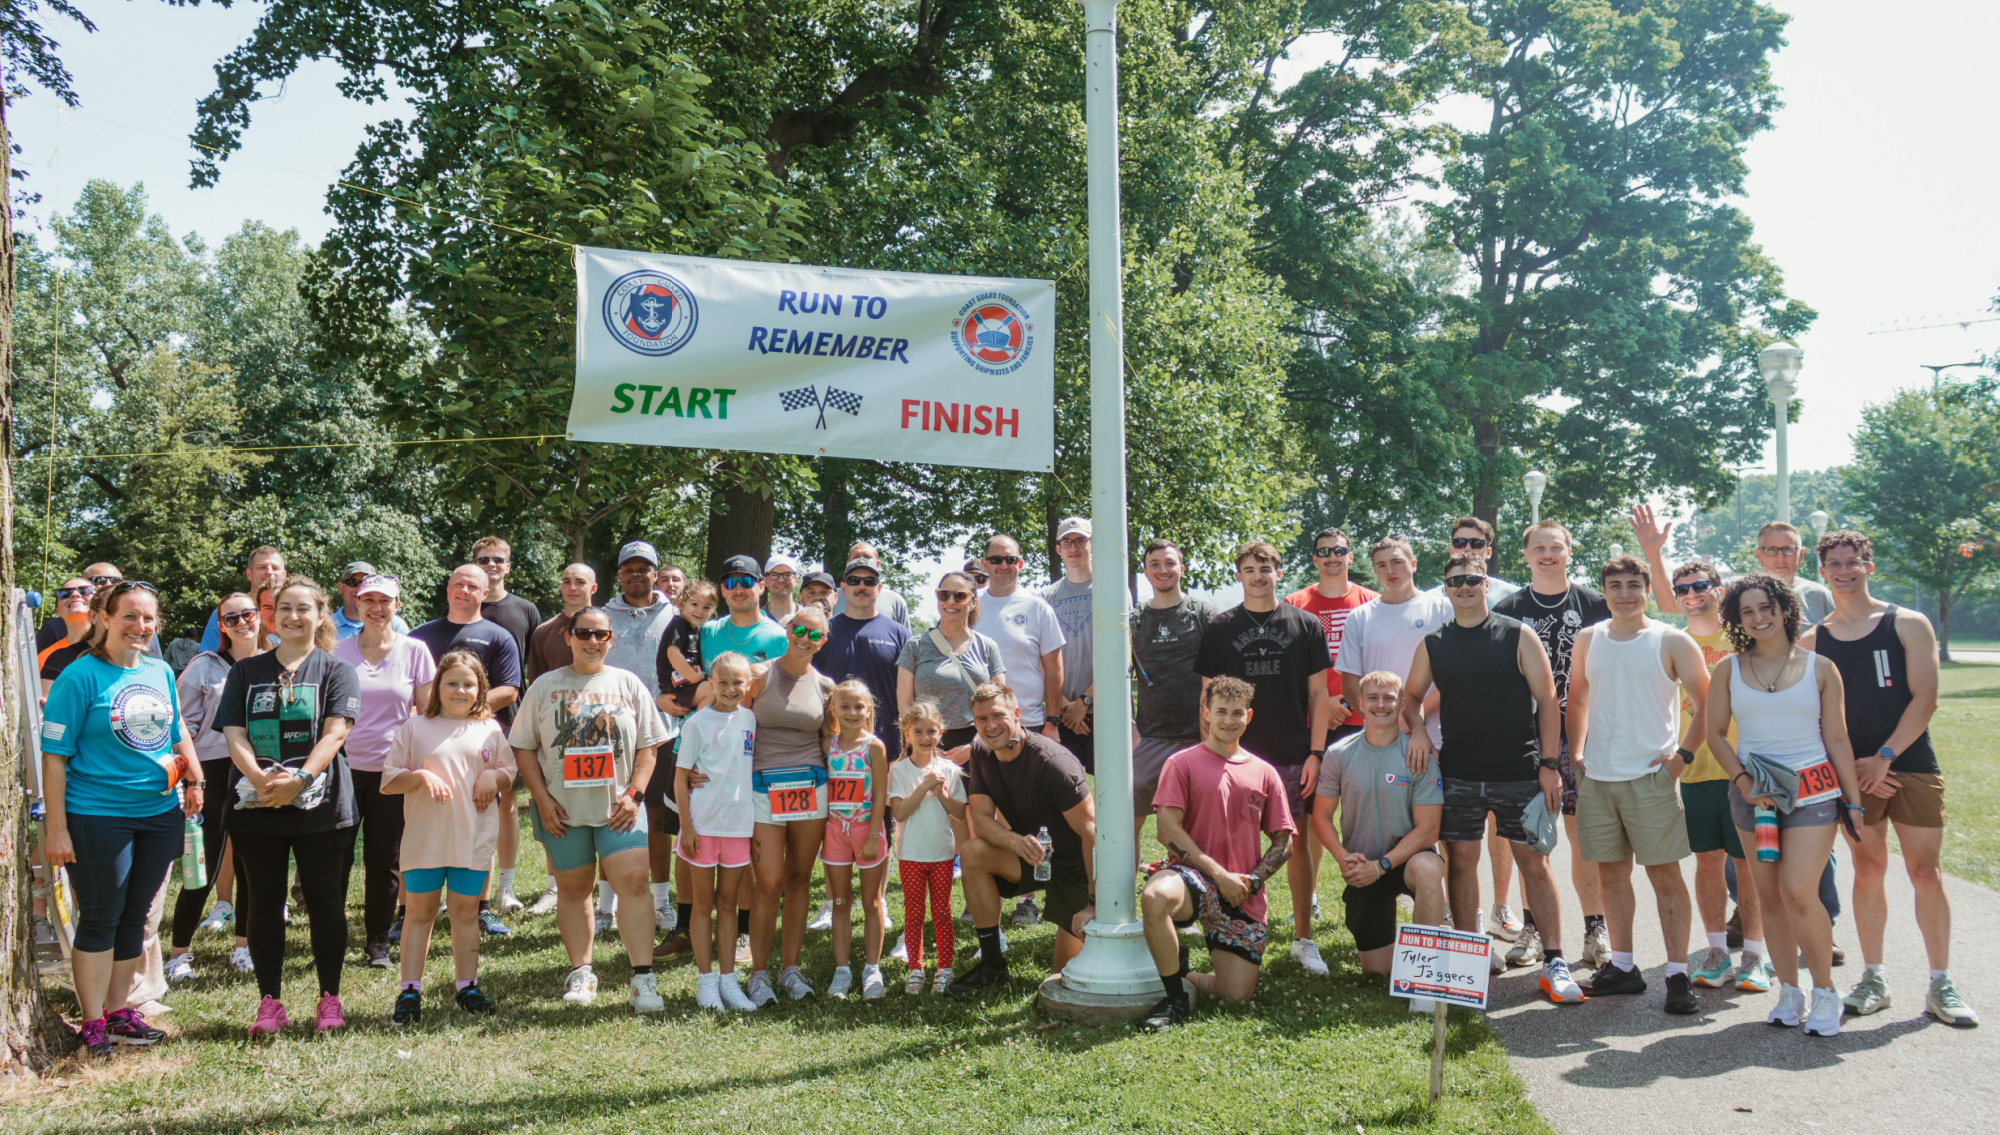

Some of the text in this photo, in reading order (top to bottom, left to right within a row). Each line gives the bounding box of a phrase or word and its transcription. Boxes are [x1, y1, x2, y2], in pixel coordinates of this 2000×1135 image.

[617, 278, 684, 300] COAST GUARD
[778, 289, 887, 320] RUN TO
[958, 292, 1030, 320] COAST GUARD FOUNDATION
[622, 329, 679, 348] FOUNDATION
[748, 326, 909, 365] REMEMBER
[950, 330, 1034, 376] SUPPORTING SHIPMATES AND FAMILIES
[609, 382, 737, 420] START
[901, 398, 1019, 438] FINISH
[1232, 626, 1294, 652] AMERICAN
[1245, 660, 1281, 677] EAGLE
[550, 688, 589, 705] STAY
[573, 755, 606, 778] 137
[830, 780, 857, 801] 127
[1800, 765, 1835, 794] 139
[778, 790, 810, 812] 128
[1402, 935, 1485, 955] RUN TO REMEMBER
[1420, 929, 1439, 937] GUARD
[1440, 932, 1473, 942] FOUNDATION
[1401, 950, 1439, 965] Tyler
[1413, 964, 1475, 985] Jaggers
